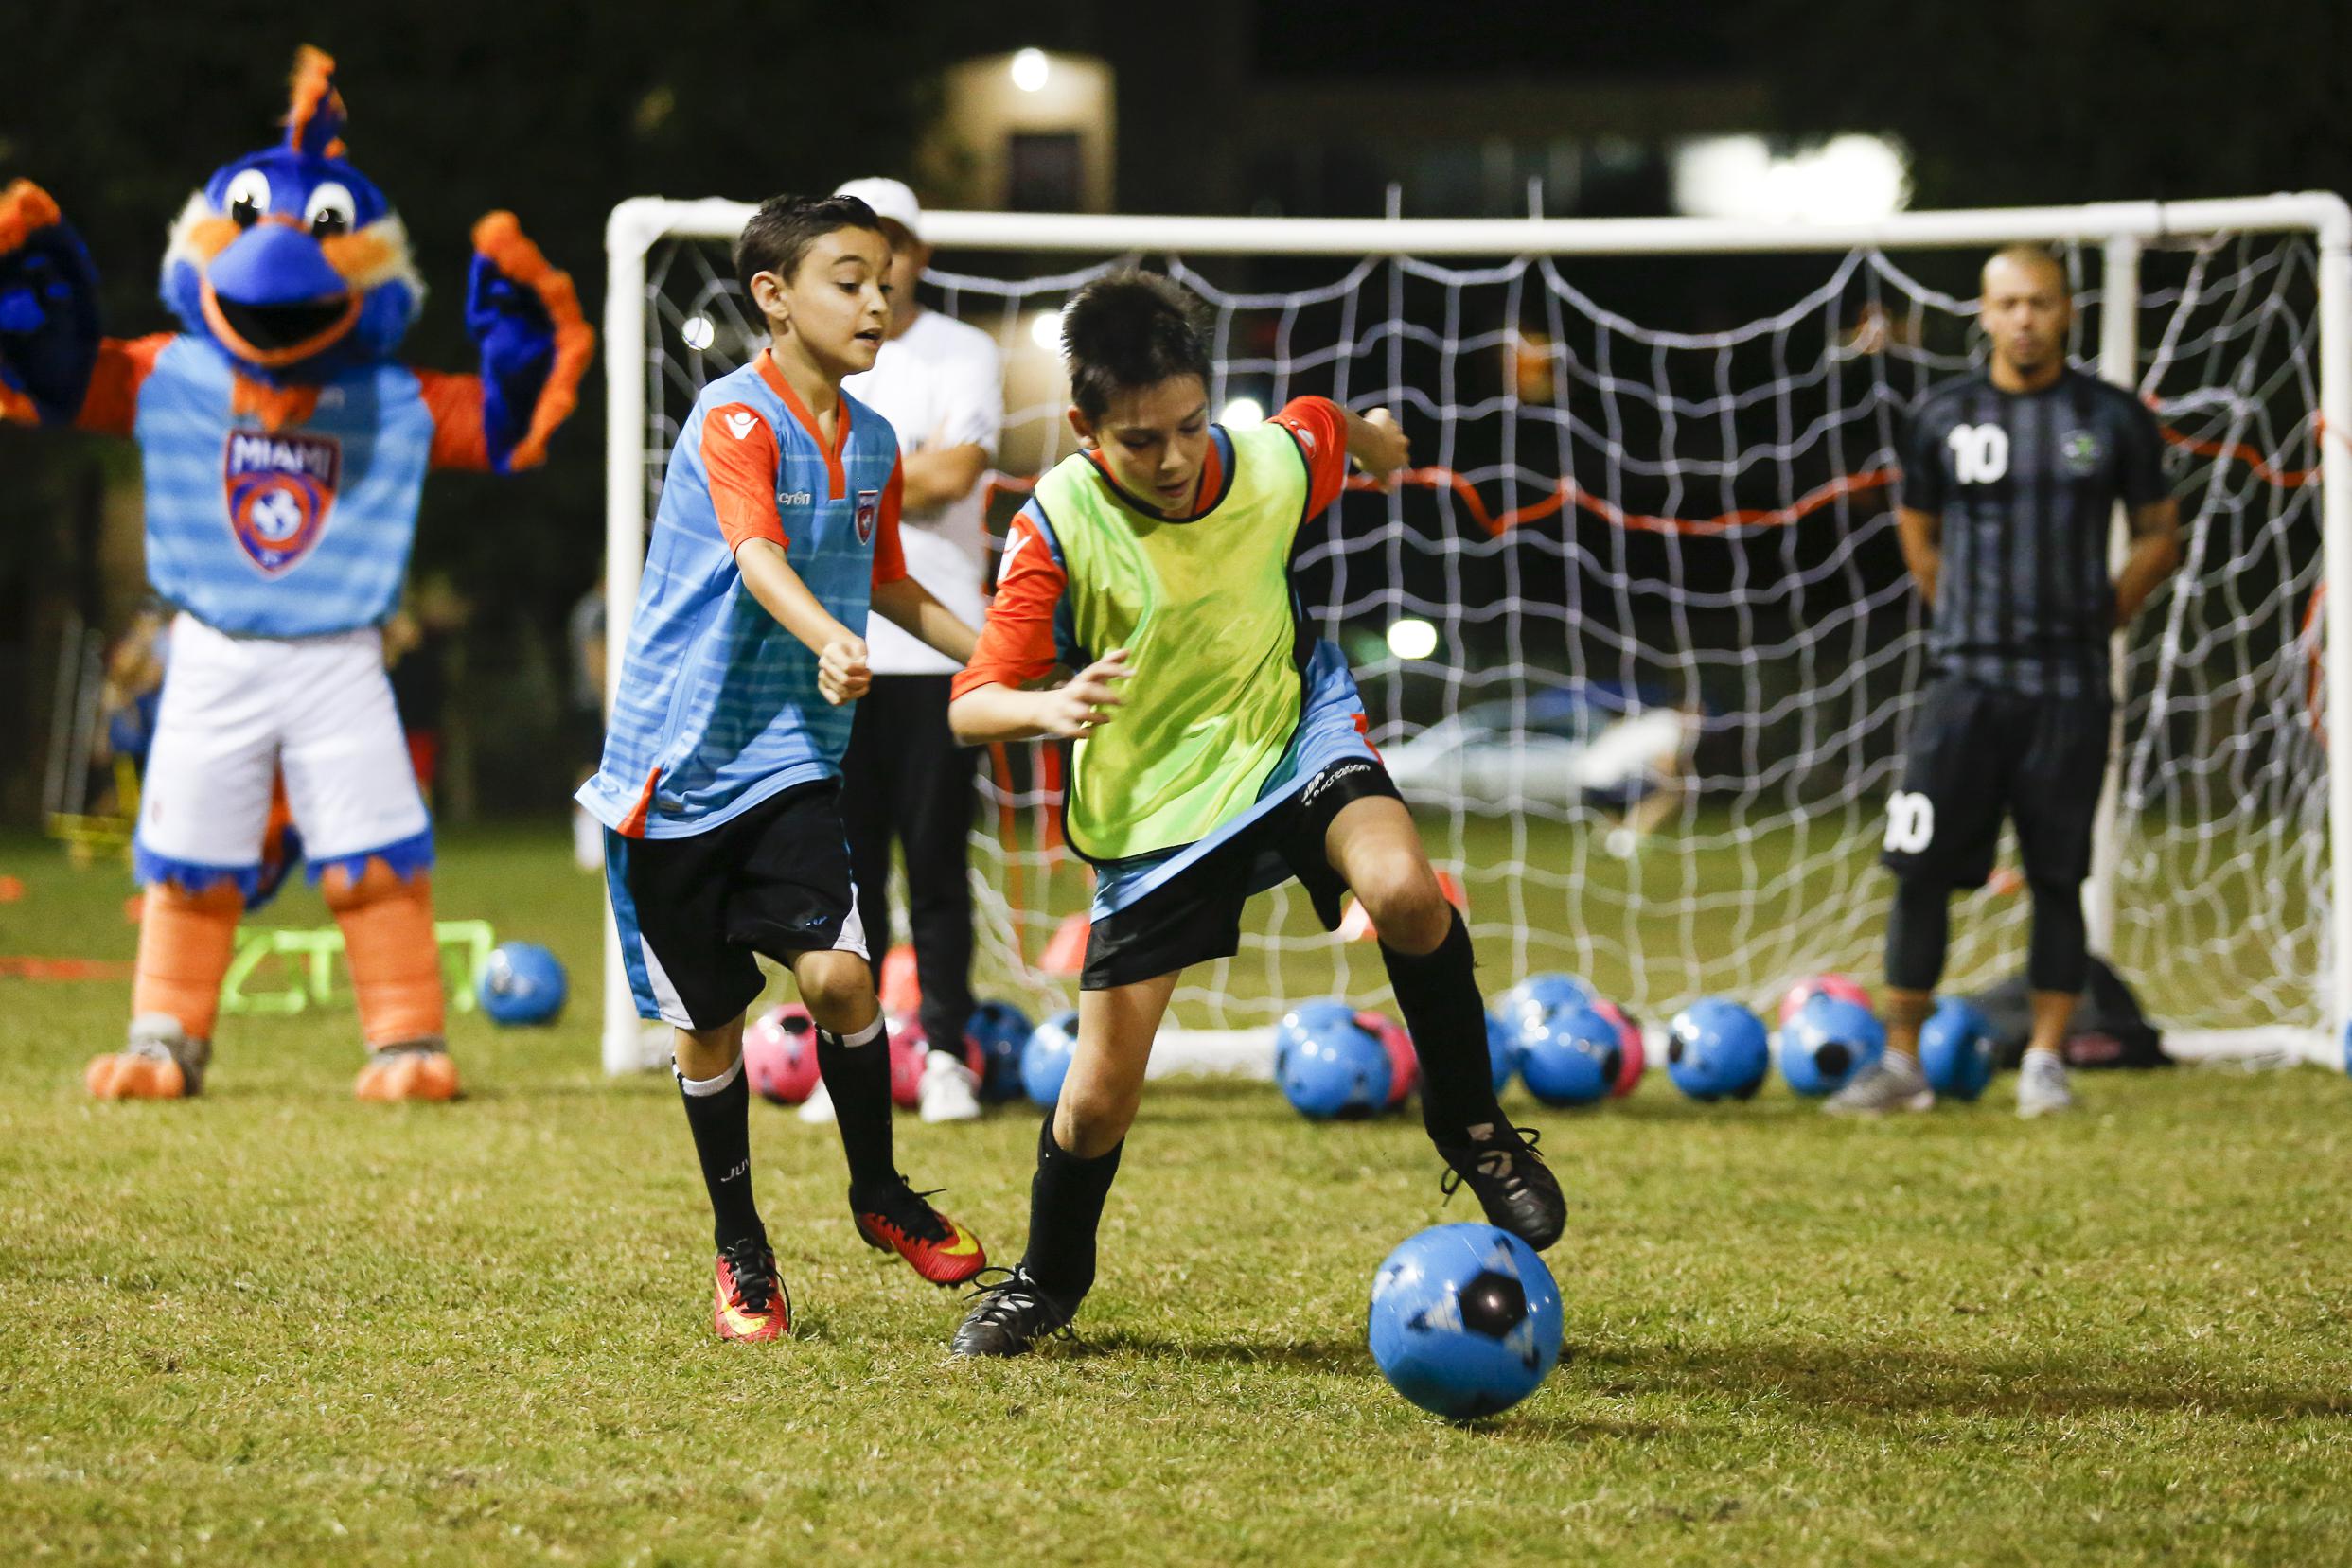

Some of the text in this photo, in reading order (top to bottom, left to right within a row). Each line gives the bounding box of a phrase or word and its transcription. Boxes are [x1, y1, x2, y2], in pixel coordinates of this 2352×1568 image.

[232, 434, 329, 478] MIAMI
[1948, 423, 2008, 484] 10
[1883, 791, 1934, 853] 10
